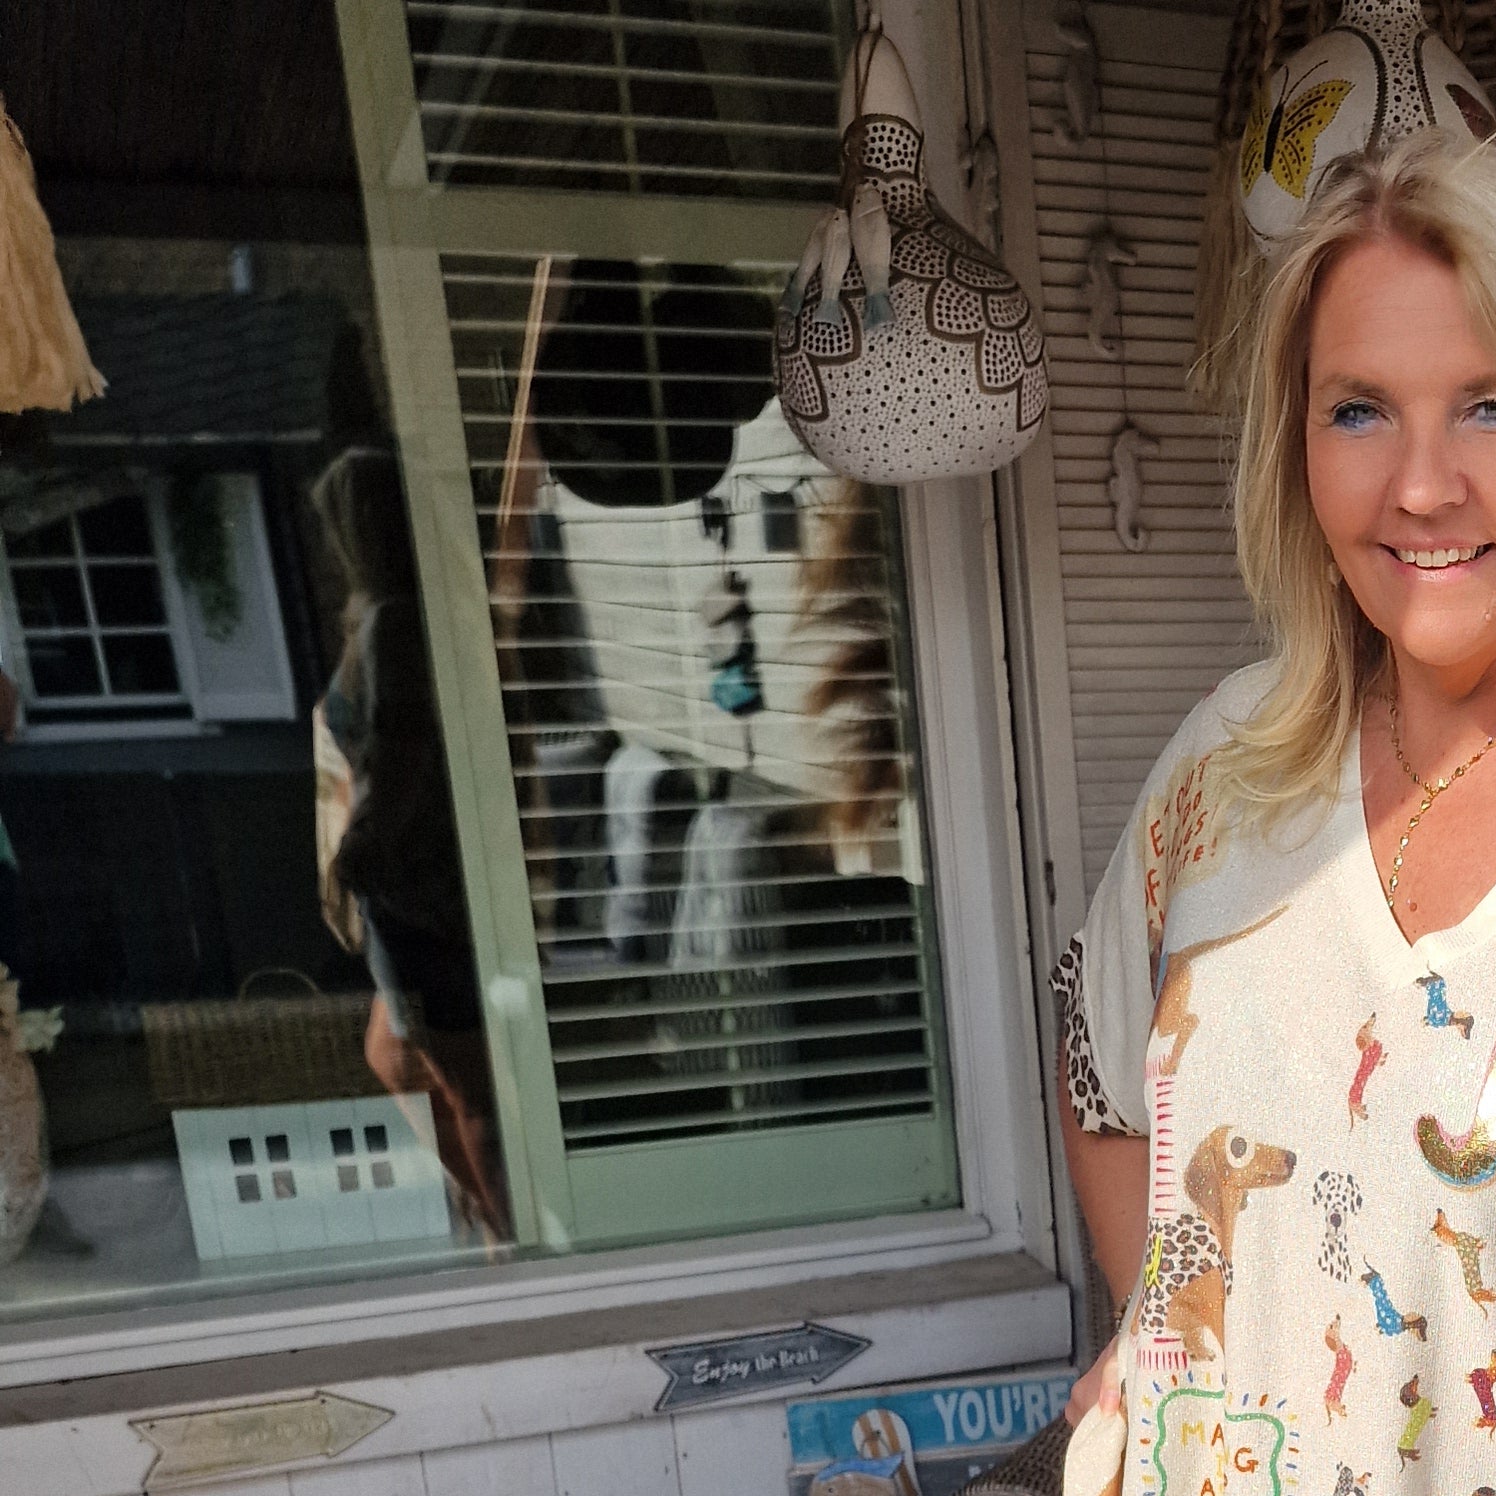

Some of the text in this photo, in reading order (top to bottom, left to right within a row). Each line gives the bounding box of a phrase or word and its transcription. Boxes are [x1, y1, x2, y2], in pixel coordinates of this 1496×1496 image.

[692, 1345, 819, 1385] Enjoy the Beach
